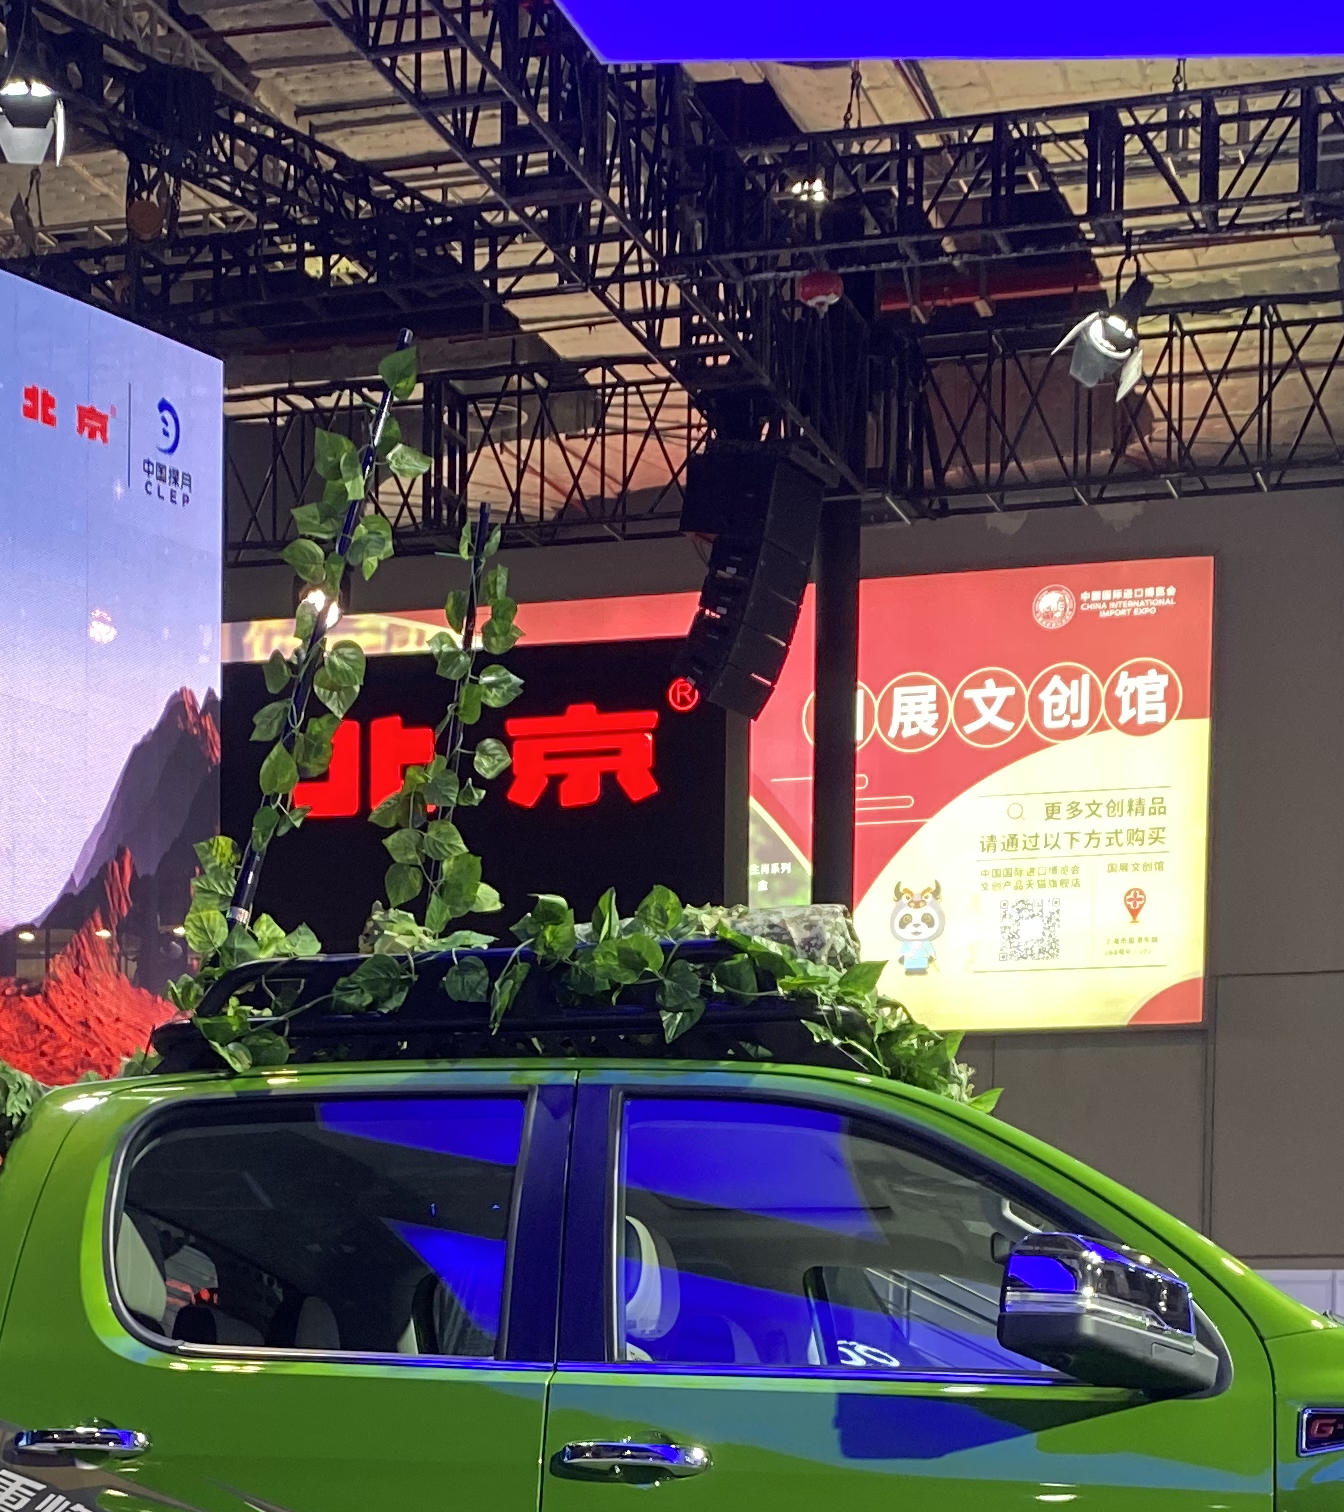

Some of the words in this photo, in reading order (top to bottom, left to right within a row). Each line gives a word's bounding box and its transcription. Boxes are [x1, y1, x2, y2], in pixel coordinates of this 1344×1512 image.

[22, 384, 110, 445] 北京
[142, 458, 193, 494] 中国探月
[144, 480, 191, 507] CLEP
[1080, 602, 1107, 611] CHINA
[1108, 597, 1177, 609] INTERNATIONAL
[1099, 608, 1132, 618] IMPORT
[1133, 606, 1157, 616] EXPO
[855, 668, 1172, 742] 展文创馆
[1044, 797, 1168, 821] 更多文创精品
[979, 826, 1167, 854] 请通过以下方式购买
